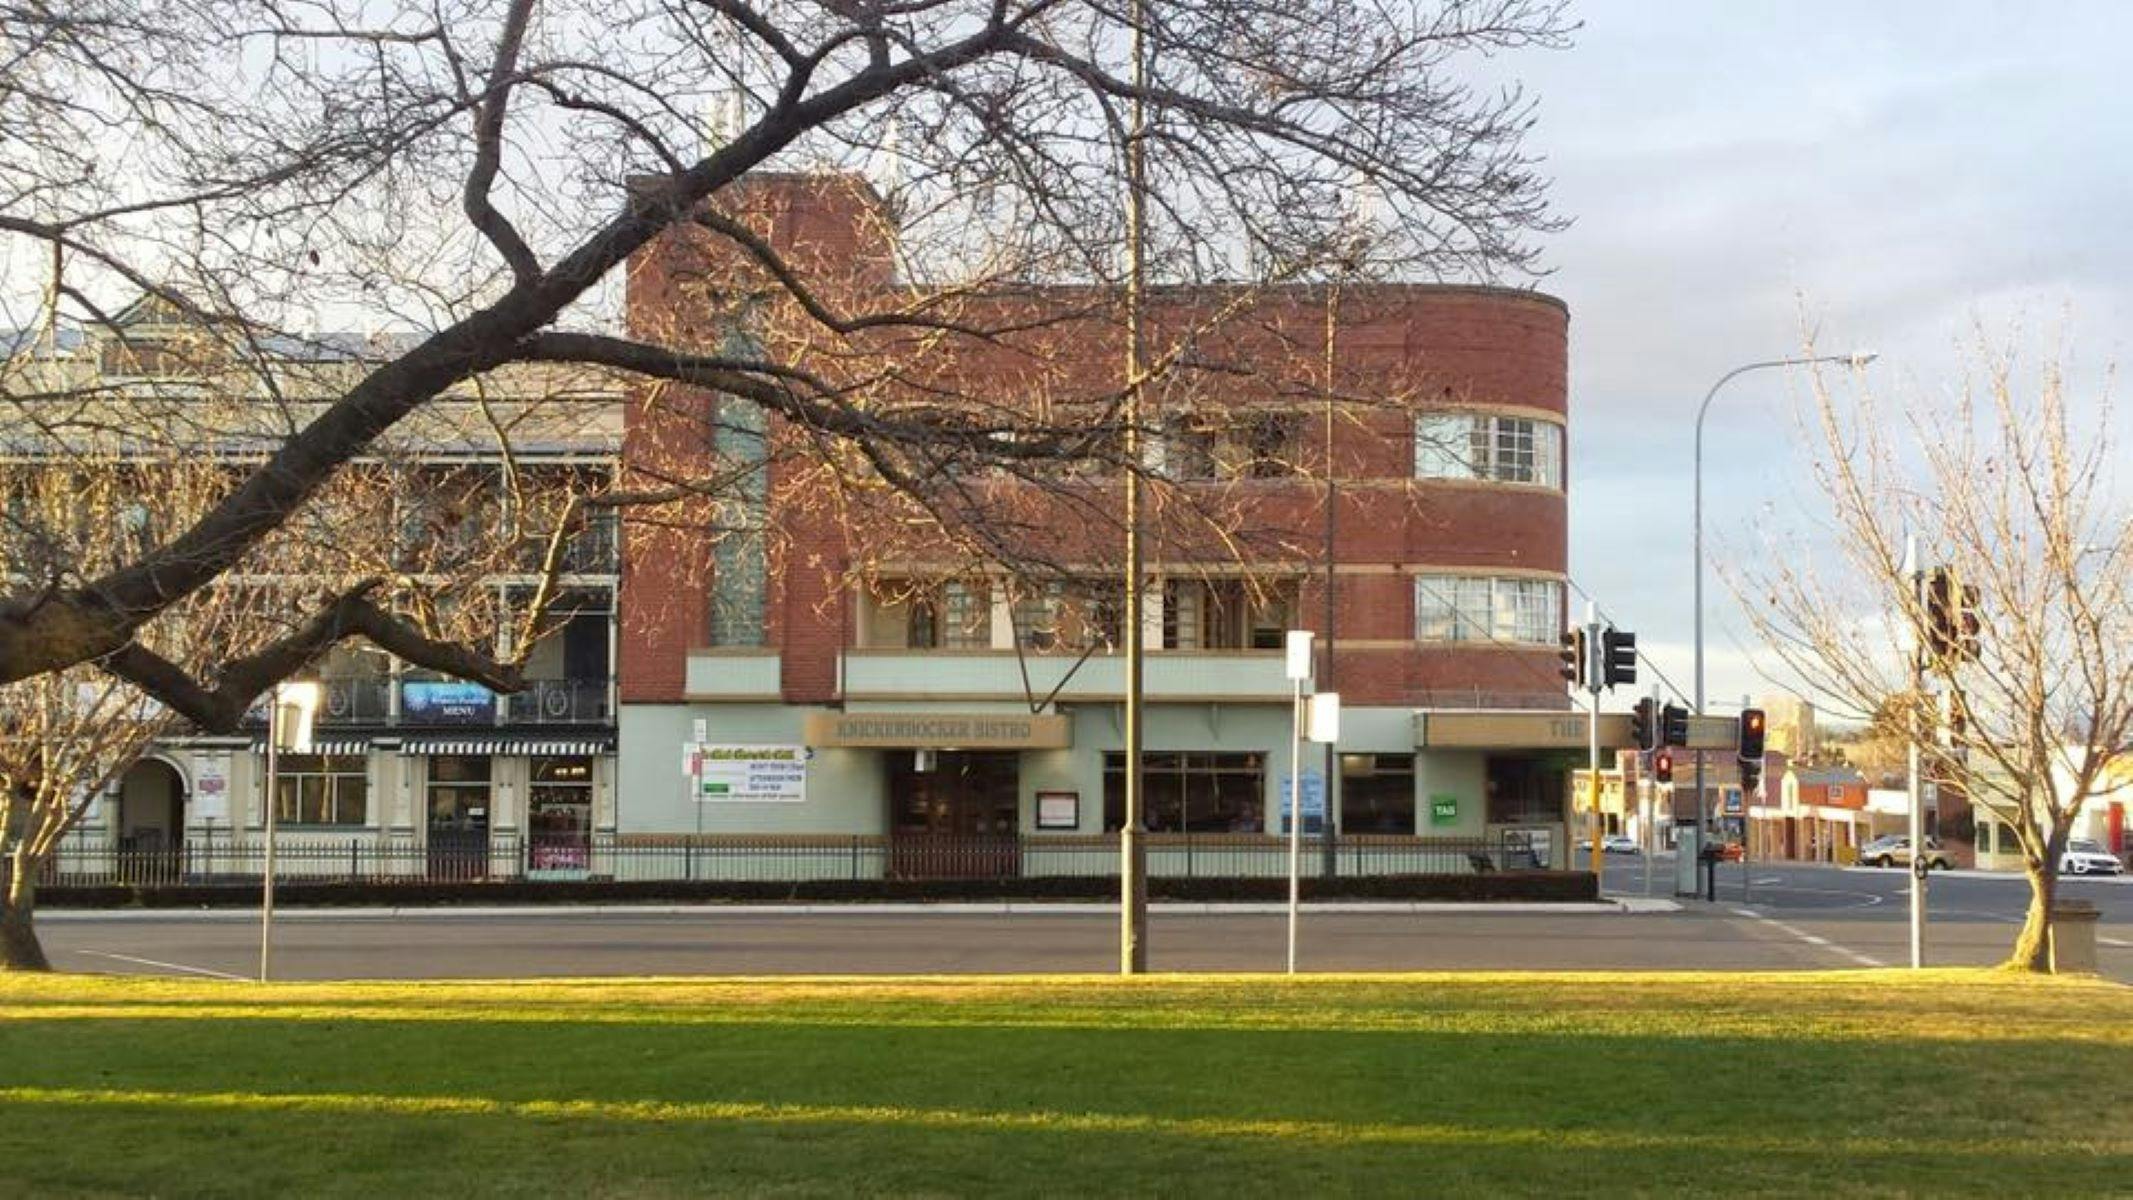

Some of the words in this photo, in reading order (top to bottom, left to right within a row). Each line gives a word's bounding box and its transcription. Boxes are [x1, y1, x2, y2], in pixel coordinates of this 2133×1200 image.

[442, 706, 476, 717] MENU
[837, 719, 969, 738] KNICKERBOCKER
[974, 719, 1032, 738] BISTRO
[1551, 720, 1584, 737] THE
[1435, 804, 1456, 816] TAB
